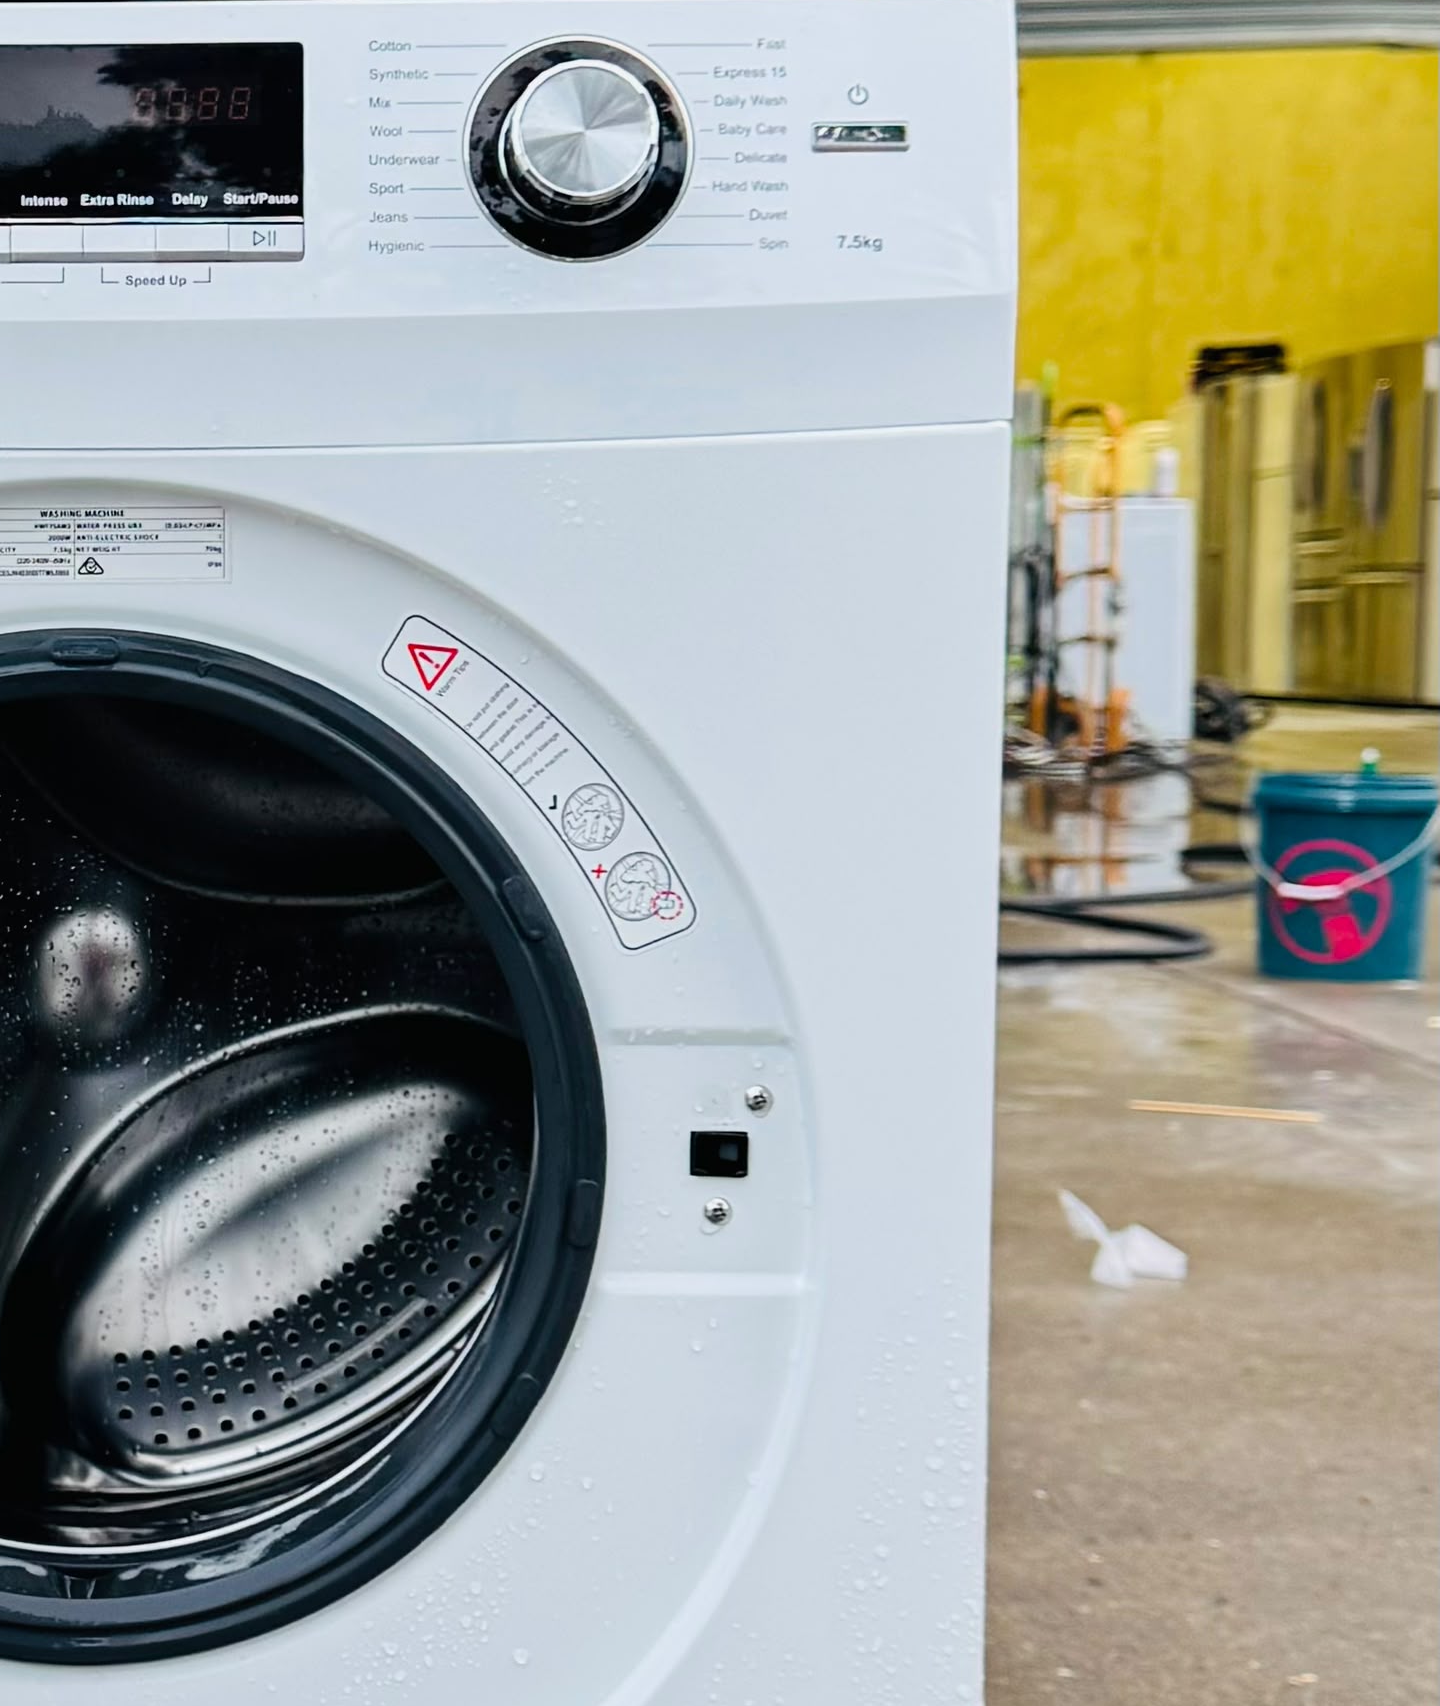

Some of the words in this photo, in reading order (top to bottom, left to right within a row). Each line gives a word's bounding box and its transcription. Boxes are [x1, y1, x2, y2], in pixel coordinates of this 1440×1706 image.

[369, 40, 411, 52] Cotton
[369, 68, 429, 82] Synthetic
[713, 66, 766, 79] Express
[772, 66, 787, 78] 15
[369, 97, 391, 108] Mix
[714, 94, 746, 109] Daily
[750, 95, 787, 106] Wash
[369, 125, 402, 137] Wool
[718, 123, 751, 137] Baby
[756, 123, 787, 135] Care
[369, 154, 440, 166] Underwear
[735, 152, 787, 163] Delicate
[369, 182, 404, 196] Sport
[712, 181, 747, 192] Hand
[751, 180, 788, 192] Wash
[21, 195, 68, 206] Intense
[80, 194, 114, 206] Extra
[117, 194, 154, 206] Rinse
[172, 193, 208, 207] Delay
[223, 193, 298, 205] Start/Pause
[369, 211, 408, 223] Jeans
[749, 208, 788, 221] Duvet
[369, 240, 424, 254] Hygienic
[759, 237, 789, 250] Spin
[837, 235, 883, 251] 7.5kg
[125, 275, 165, 287] Speed
[169, 275, 187, 287] Up
[40, 510, 82, 518] WASHING
[436, 675, 456, 697] Warm
[453, 660, 469, 674] Tips
